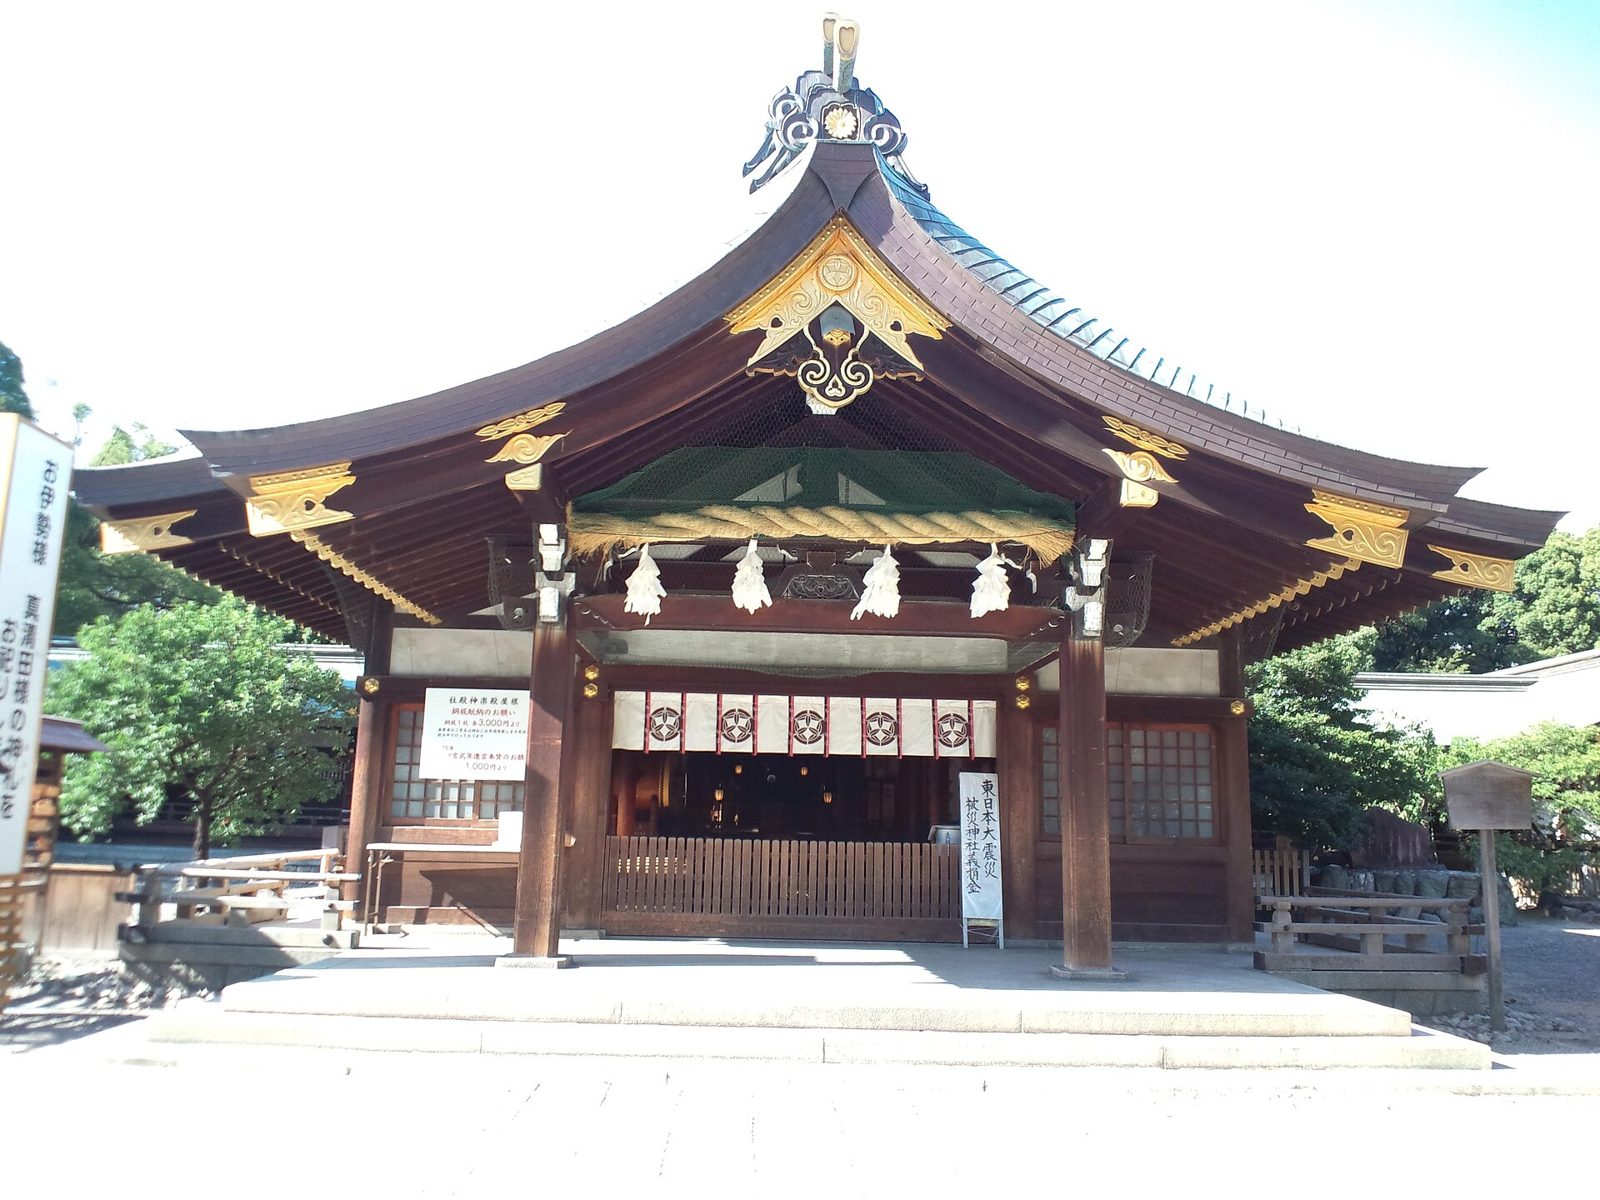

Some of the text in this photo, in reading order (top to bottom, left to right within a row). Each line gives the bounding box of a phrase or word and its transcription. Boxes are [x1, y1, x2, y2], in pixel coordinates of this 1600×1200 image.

[449, 696, 519, 705] 社殿神楽殿屋根
[965, 797, 982, 895] 被災神社義捐金
[980, 779, 998, 880] 東日本大震災
